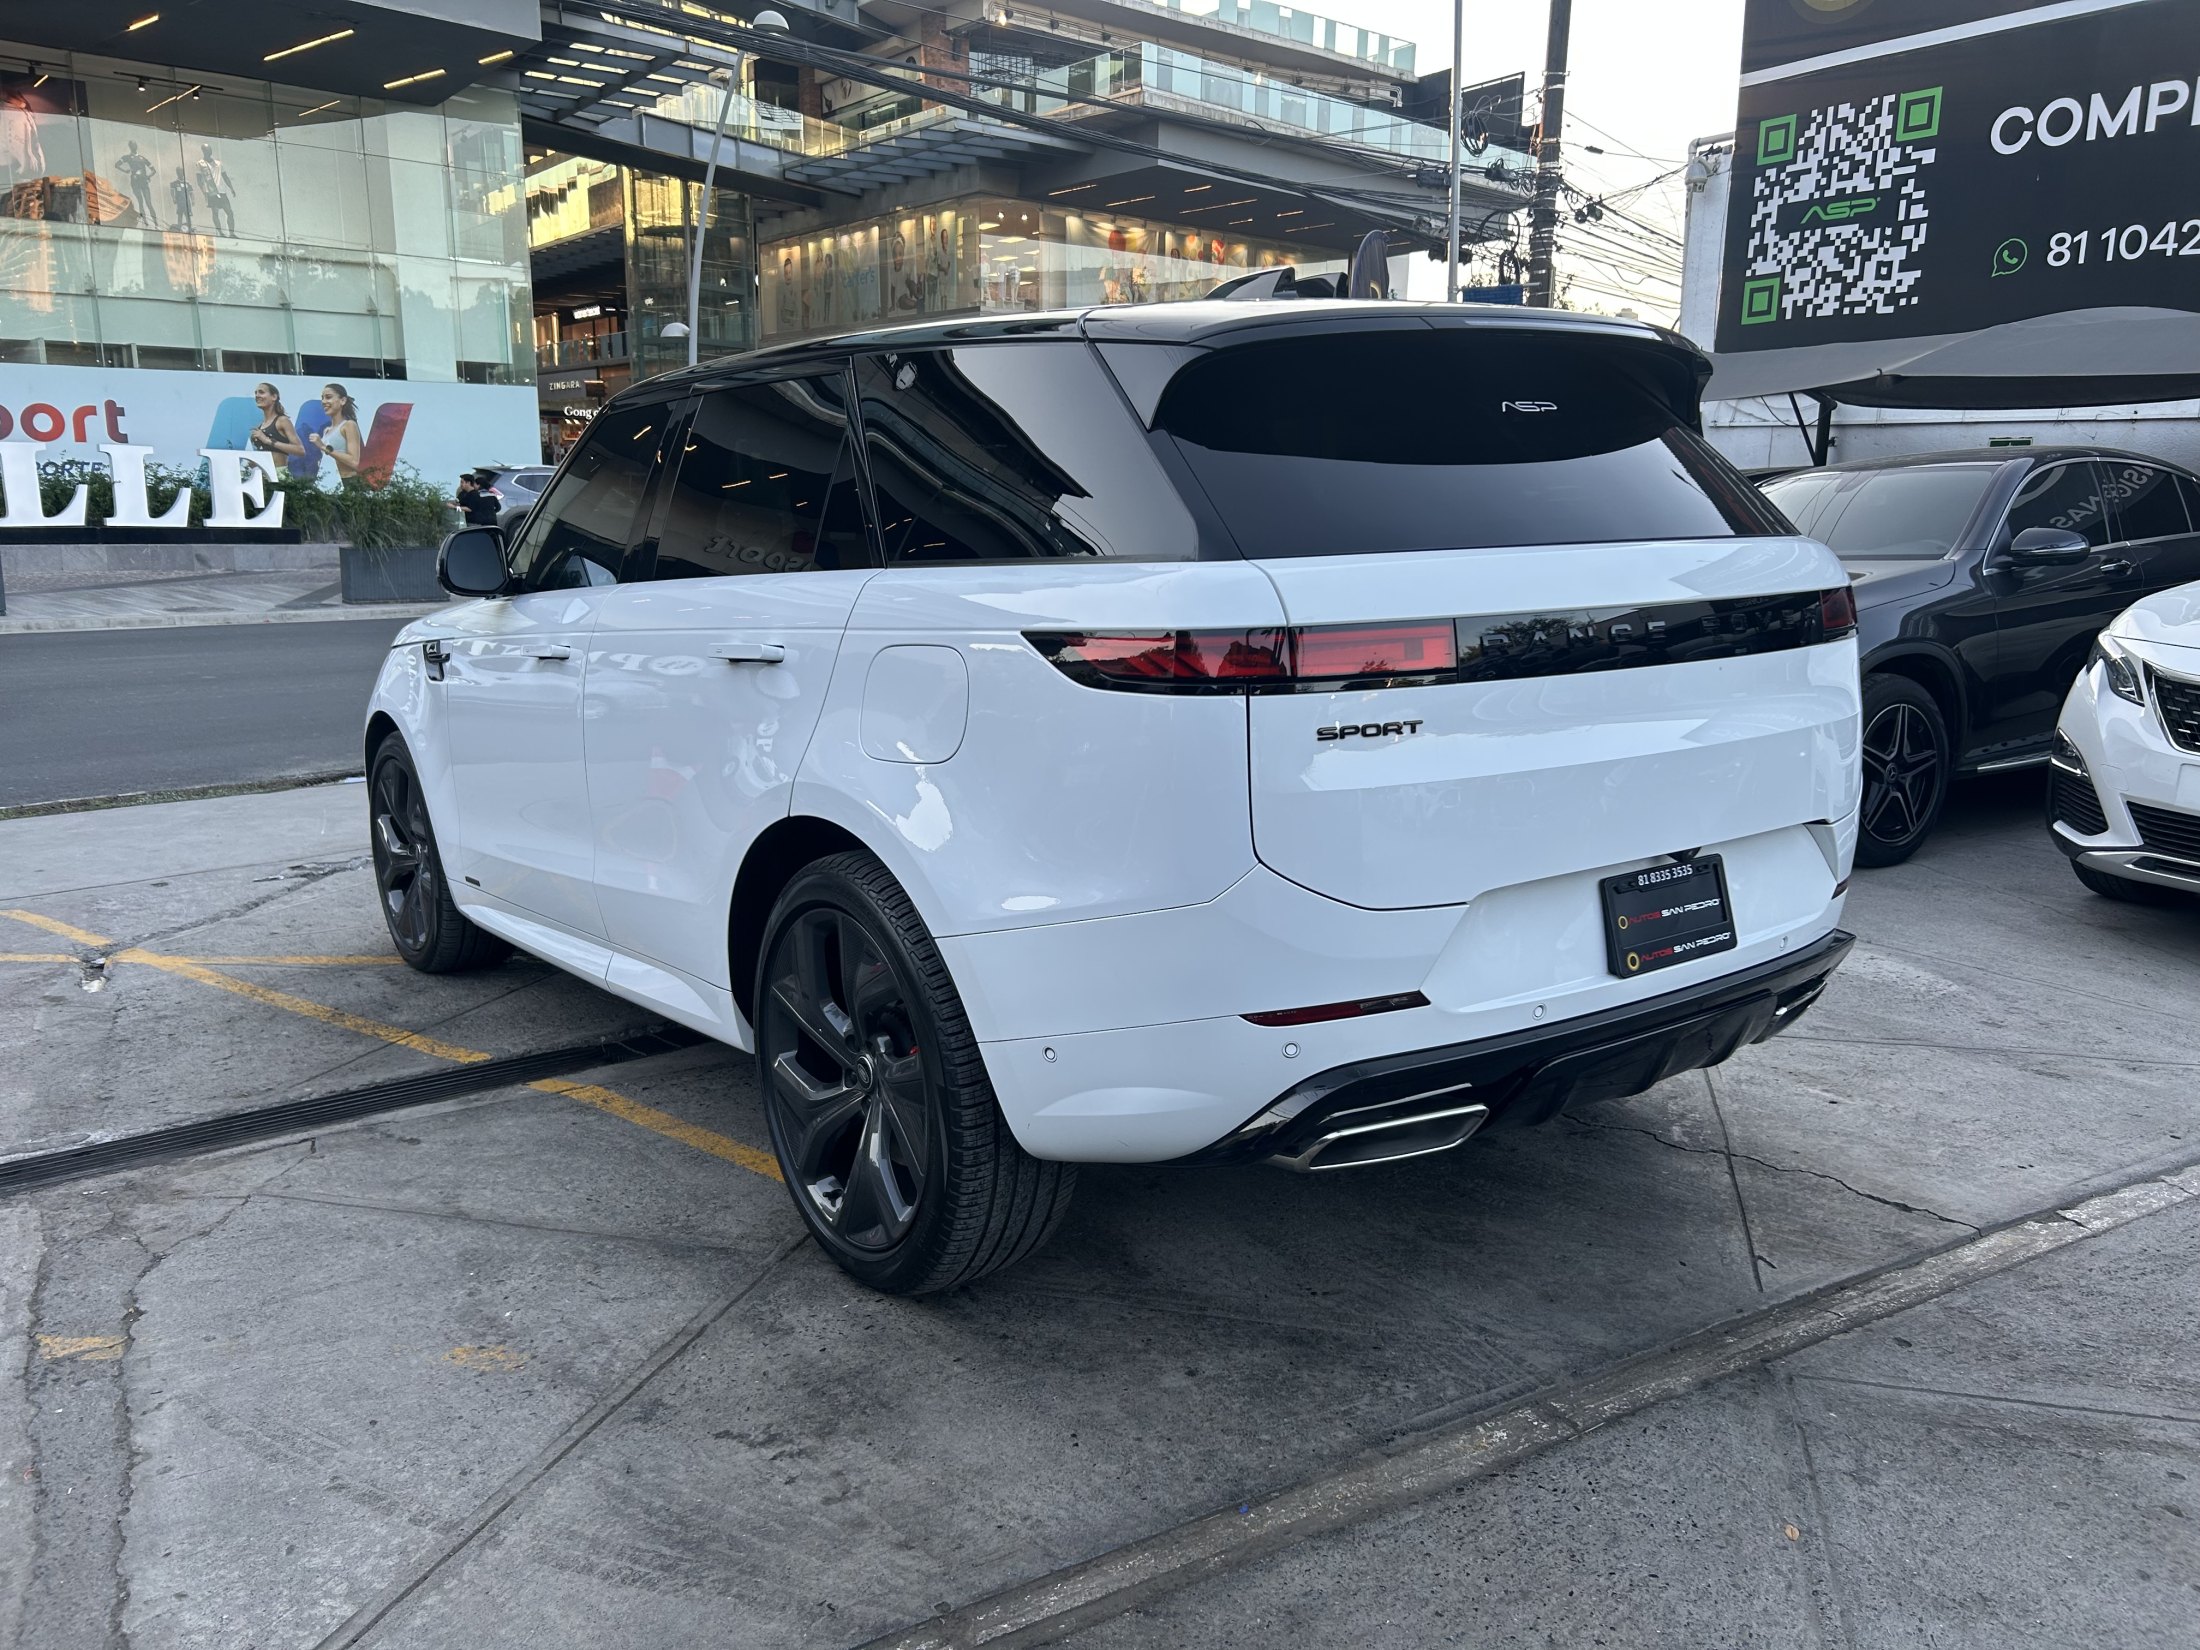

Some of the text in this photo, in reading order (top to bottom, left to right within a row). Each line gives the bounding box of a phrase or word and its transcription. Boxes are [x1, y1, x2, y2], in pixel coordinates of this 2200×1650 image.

[2046, 218, 2200, 267] 81 1042
[549, 380, 581, 391] ZINGARA
[564, 406, 592, 420] Gong
[1480, 620, 1668, 656] RANGE
[1316, 719, 1424, 741] SPORT
[1638, 863, 1694, 886] 81 8335 3535
[1628, 898, 1720, 925] AUTOS SAN PEDRO
[1641, 932, 1731, 962] AUTOS SAN PEDRO
